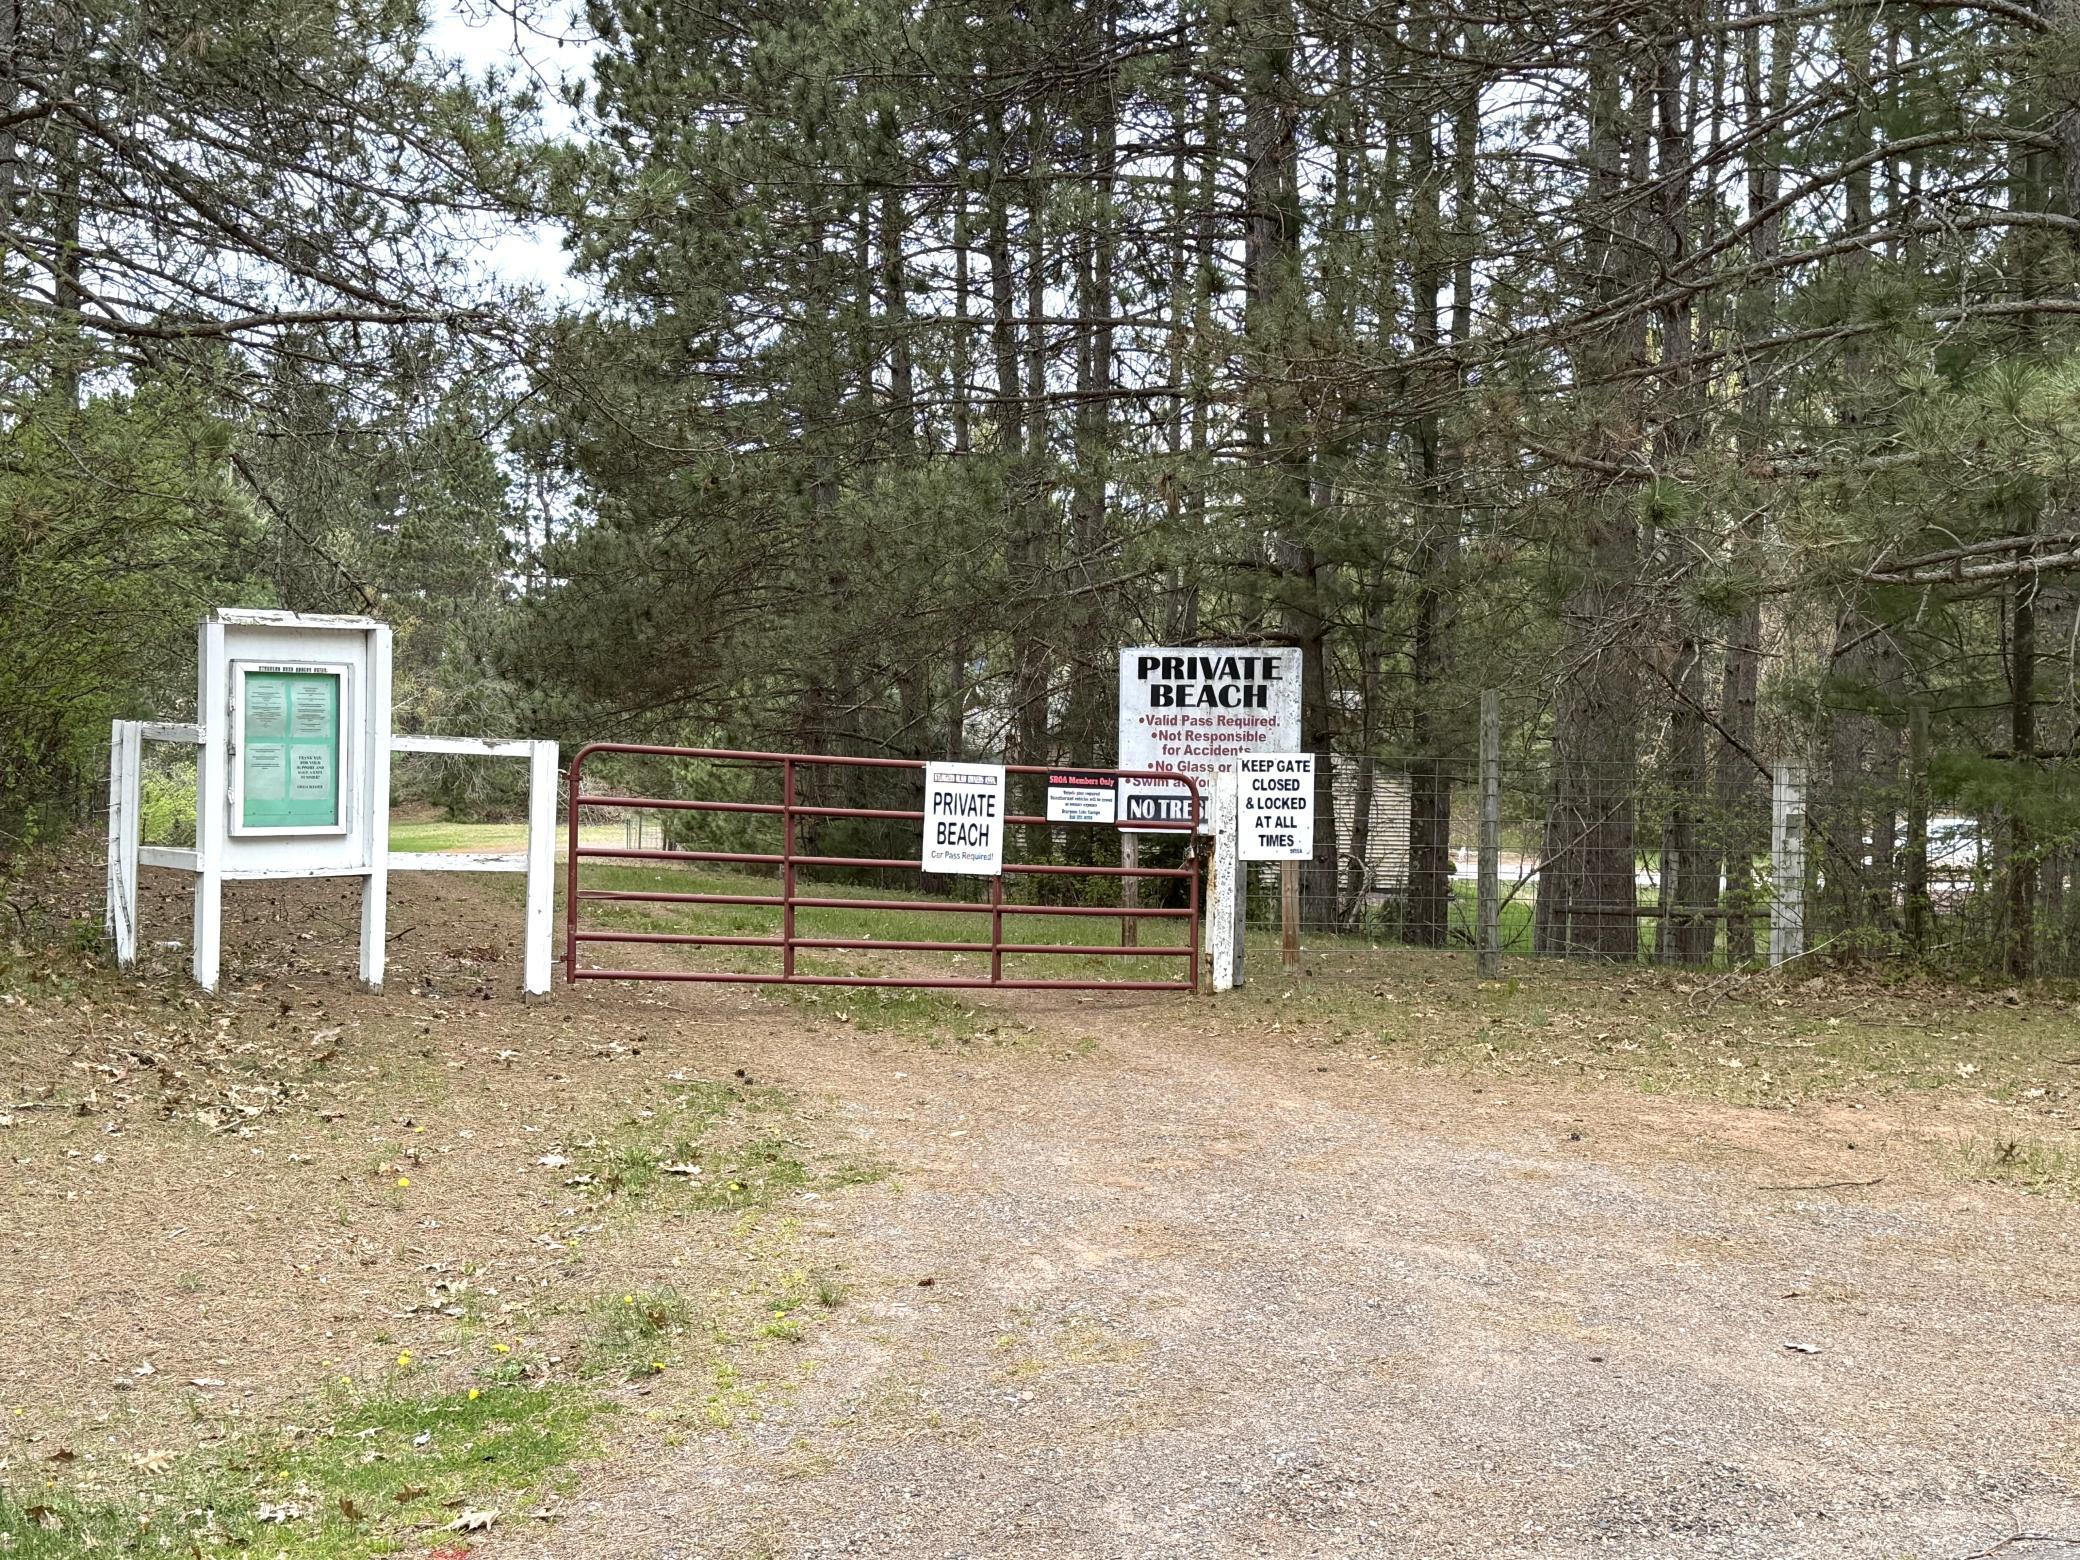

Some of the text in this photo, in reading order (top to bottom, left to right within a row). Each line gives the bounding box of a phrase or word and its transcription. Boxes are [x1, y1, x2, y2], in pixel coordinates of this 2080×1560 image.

[1138, 656, 1283, 680] PRIVATE
[1150, 684, 1268, 708] BEACH
[1146, 715, 1280, 730] Valid Pass Required.
[1158, 730, 1267, 744] Not Responsible
[1162, 744, 1181, 756] for
[1155, 760, 1232, 773] No Glass or
[1241, 759, 1311, 773] KEEP GATE
[1068, 776, 1099, 785] Members
[1099, 777, 1115, 787] Only
[1133, 777, 1168, 787] Swim
[1190, 776, 1209, 788] Yo
[1252, 778, 1300, 791] CLOSED
[933, 791, 996, 817] PRIVATE
[1246, 796, 1307, 809] & LOCKED
[1130, 799, 1209, 820] NO TRES
[1255, 816, 1298, 828] AT ALL
[937, 821, 989, 847] BEACH
[1258, 834, 1294, 847] TIMES
[944, 850, 961, 860] Pass
[961, 851, 994, 861] Required!
